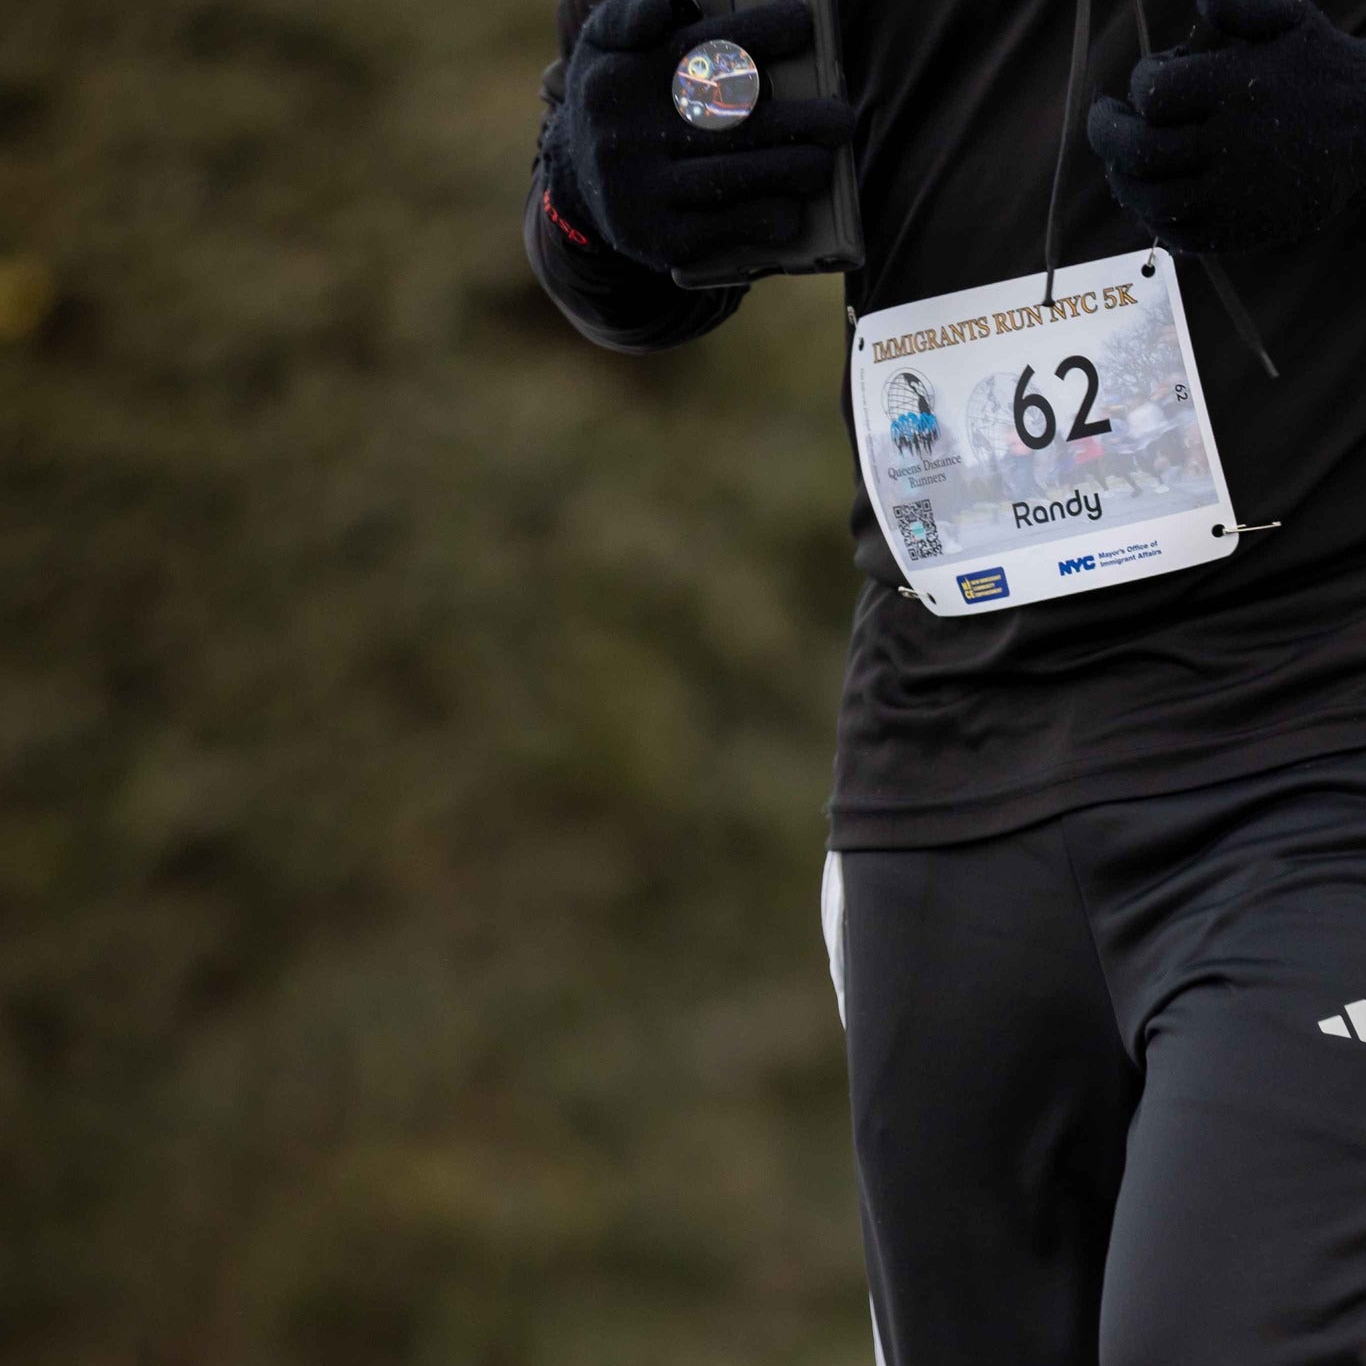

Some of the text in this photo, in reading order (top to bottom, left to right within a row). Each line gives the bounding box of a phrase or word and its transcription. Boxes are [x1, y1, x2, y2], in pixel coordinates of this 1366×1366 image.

[872, 283, 1138, 364] IMMIGRANTS RUN NYC 5K
[1013, 355, 1113, 450] 62
[1174, 384, 1188, 402] 62
[887, 455, 962, 481] Queens Distance
[908, 473, 947, 489] Runners
[1012, 489, 1103, 529] Randy
[1098, 548, 1126, 559] Mayor's
[1126, 542, 1149, 553] Office
[1100, 549, 1162, 567] Immigrant Affairs
[1058, 555, 1096, 576] NYC
